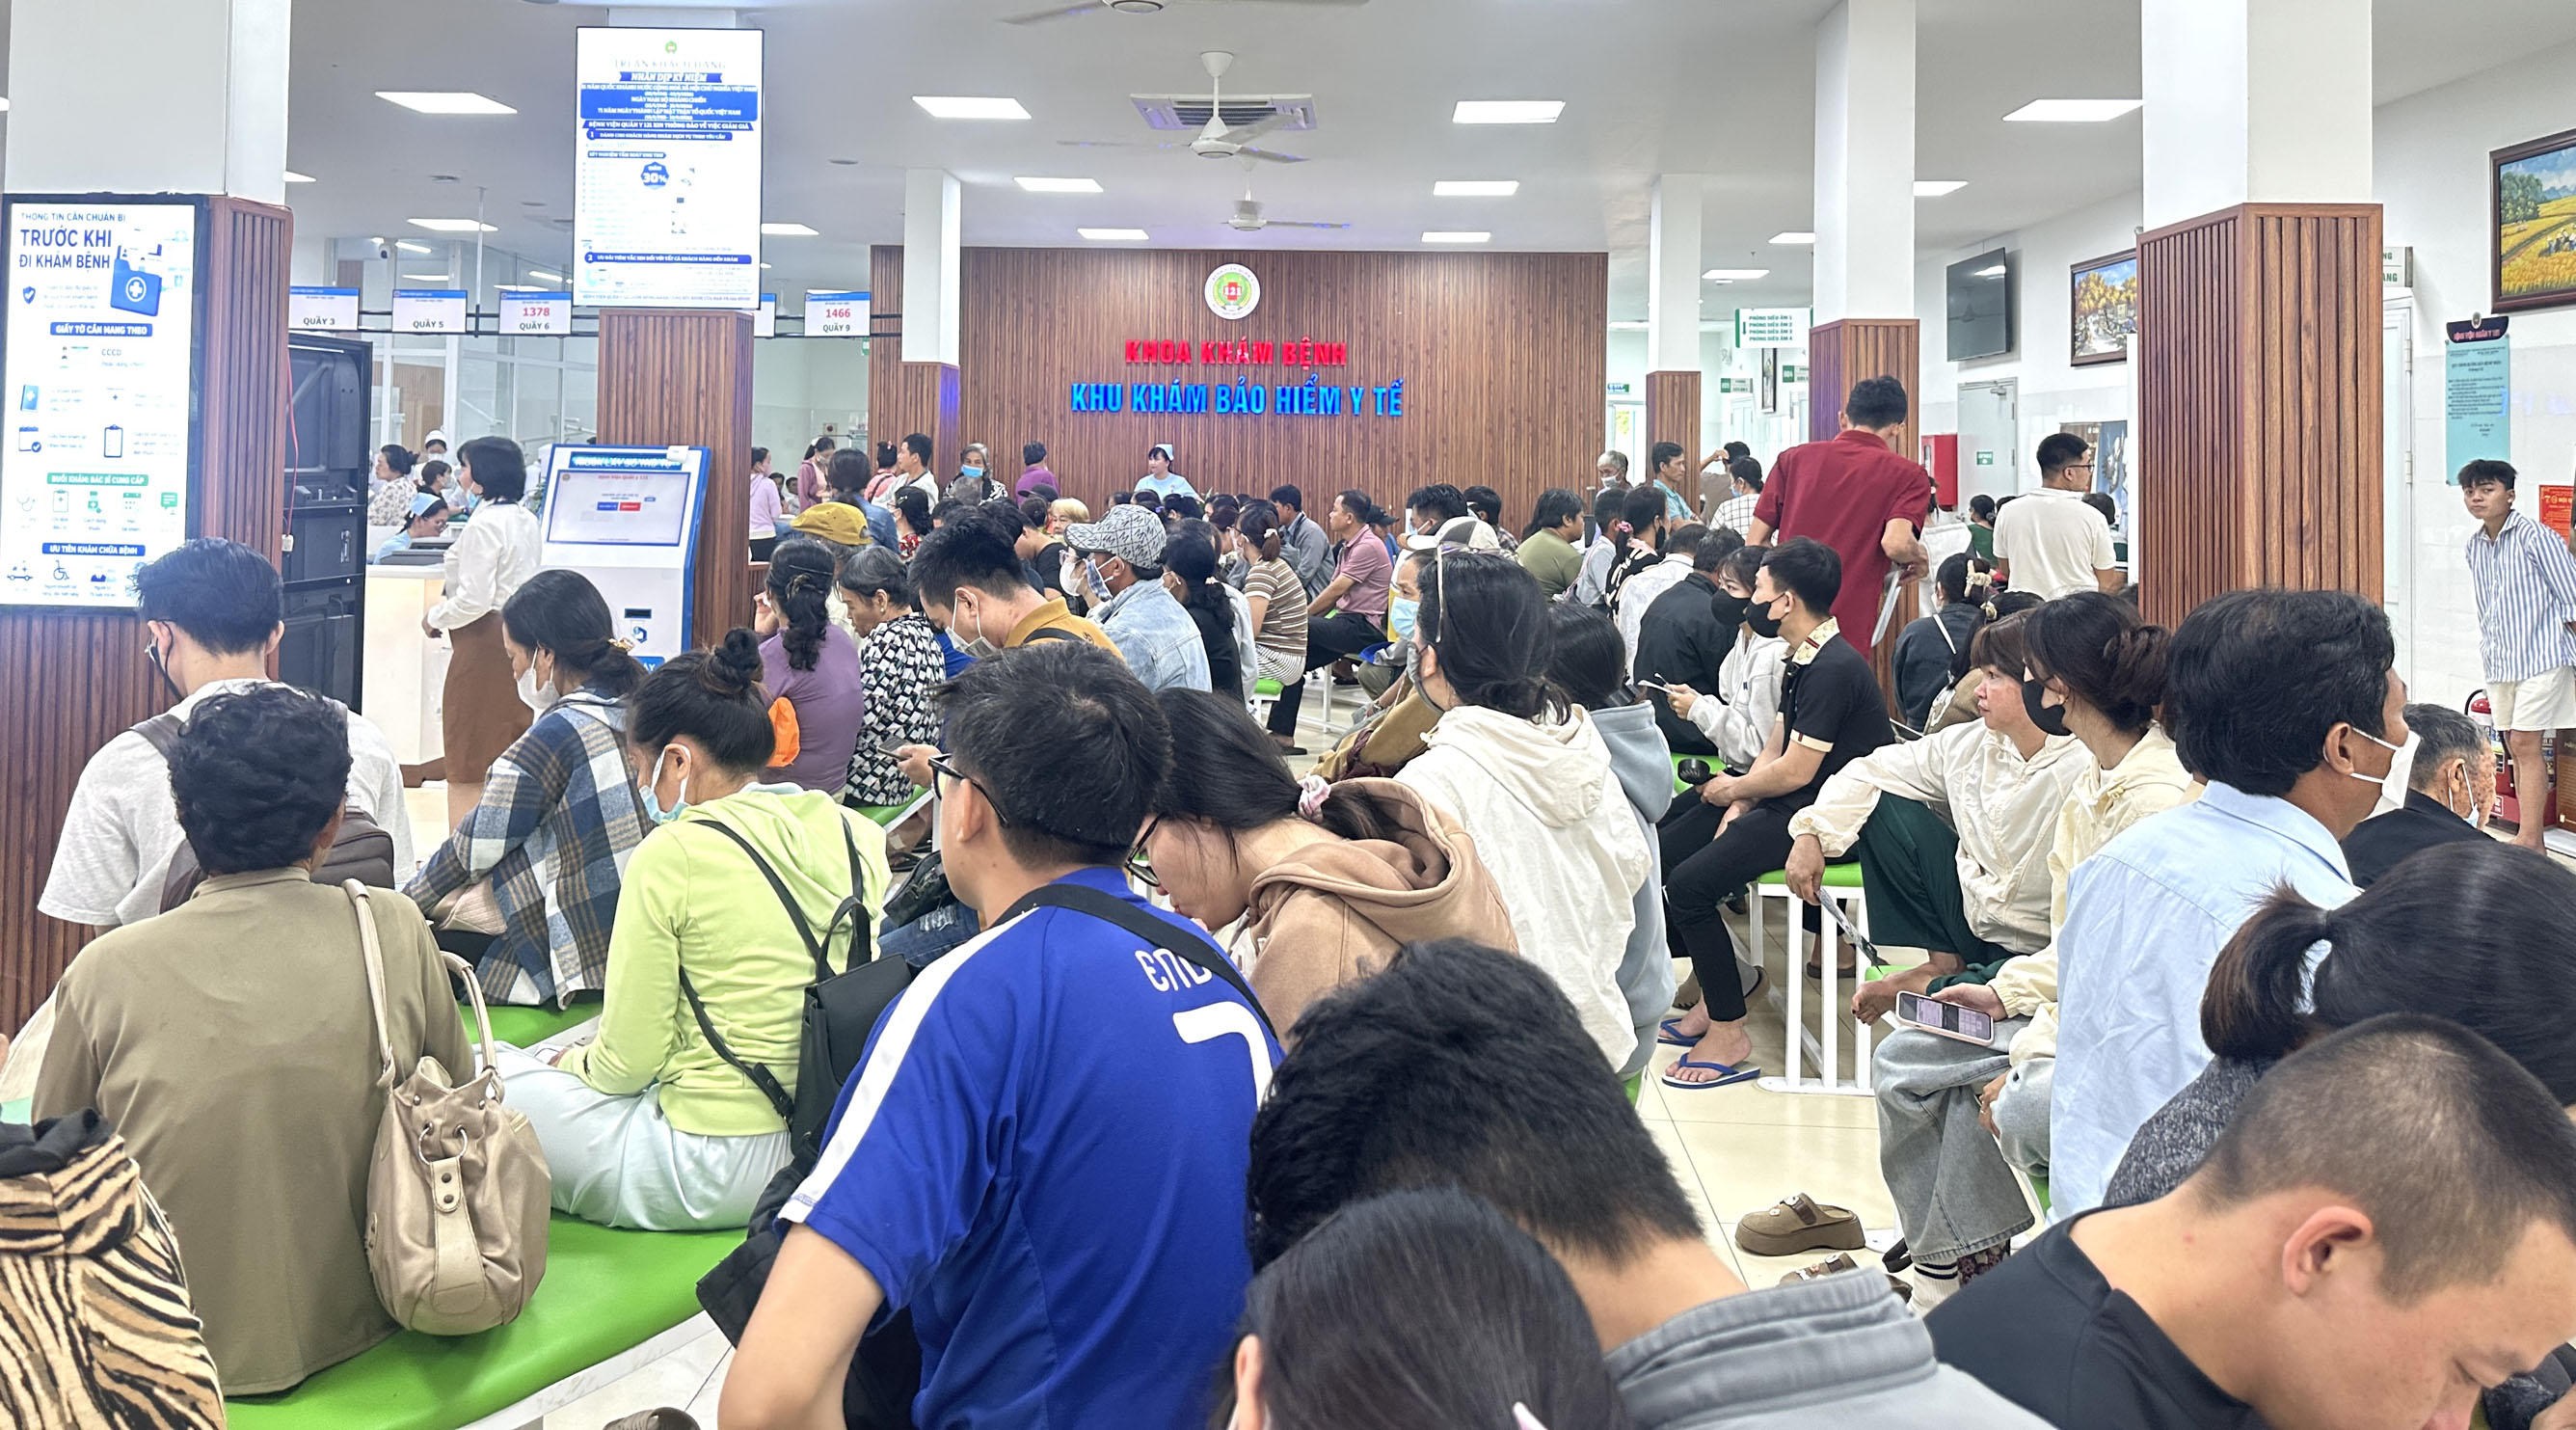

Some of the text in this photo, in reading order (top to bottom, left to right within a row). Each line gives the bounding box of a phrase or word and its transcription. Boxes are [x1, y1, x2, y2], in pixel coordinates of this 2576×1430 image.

[643, 173, 667, 183] 30%
[52, 212, 65, 221] TIN
[20, 225, 112, 248] TRƯỚC KHI
[19, 255, 32, 268] ĐI
[76, 251, 110, 274] BỆNH
[1224, 286, 1242, 295] 121
[523, 307, 550, 316] 1378
[826, 309, 850, 318] 1466
[101, 348, 122, 357] CCCD
[1125, 336, 1347, 370] KHOA KHÁM BỆNH
[1071, 372, 1404, 417] KHU KHÁM BẢO HIỂM Y TẾ
